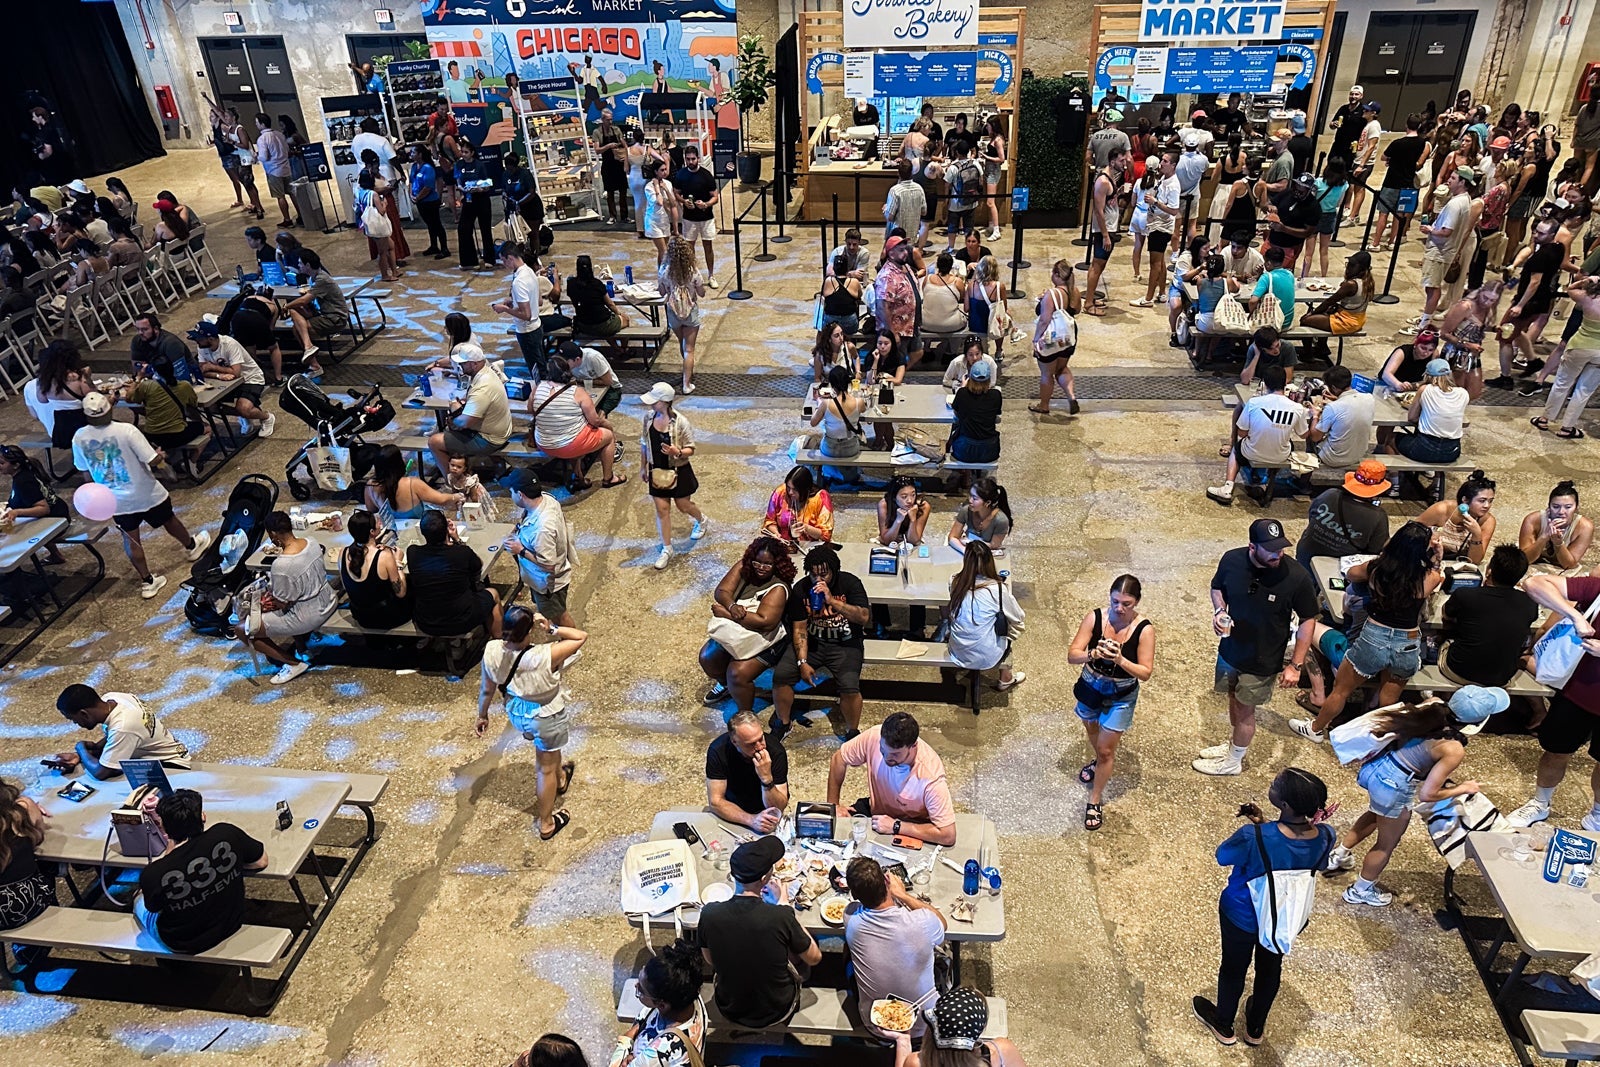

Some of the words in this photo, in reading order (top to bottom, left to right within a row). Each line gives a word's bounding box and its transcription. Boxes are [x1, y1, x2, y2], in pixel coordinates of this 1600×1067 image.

[592, 0, 642, 10] MARKET
[894, 1, 974, 39] Bakery
[1144, 6, 1282, 36] MARKET
[516, 28, 641, 60] CHICAGO
[984, 51, 1000, 59] PICK
[999, 55, 1008, 64] UP
[1302, 49, 1311, 58] UP
[809, 58, 821, 79] ORDER
[1098, 52, 1113, 74] ORDER
[1303, 60, 1313, 78] HERE
[1260, 408, 1294, 425] VIII
[827, 624, 852, 638] IT'S
[161, 842, 237, 899] 333
[641, 868, 681, 882] RECOMMENDATIONS
[168, 869, 240, 911] HALF-EVIL
[641, 876, 666, 888] RESTAURANT
